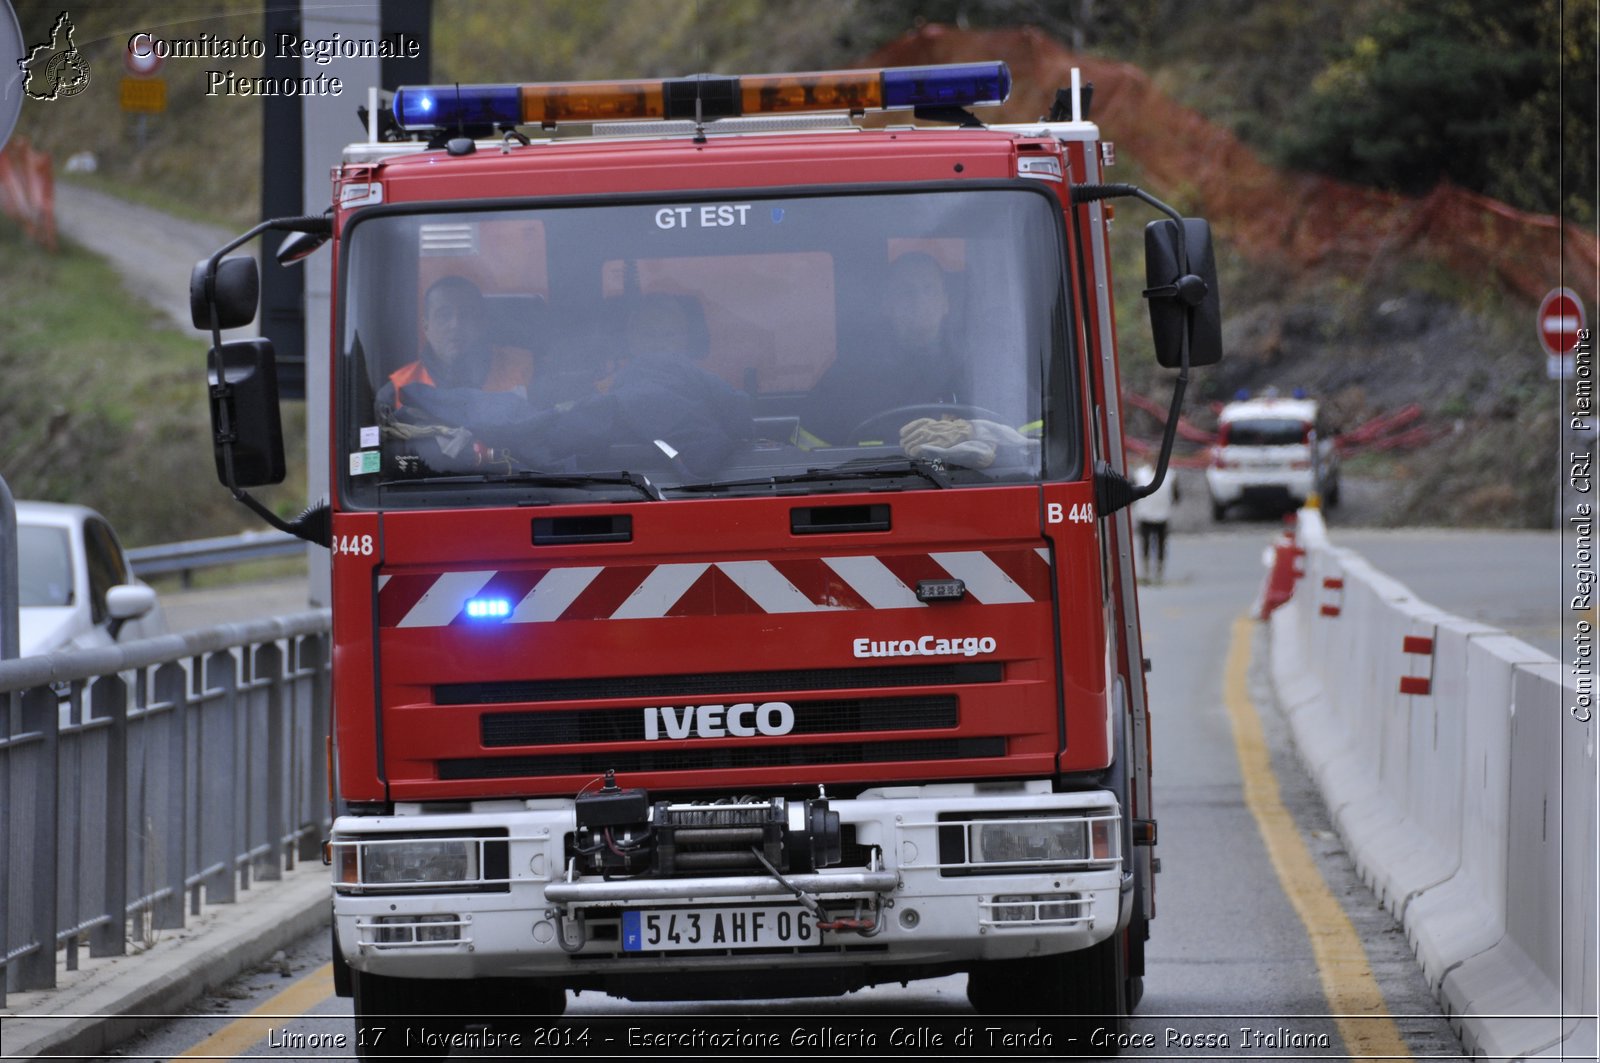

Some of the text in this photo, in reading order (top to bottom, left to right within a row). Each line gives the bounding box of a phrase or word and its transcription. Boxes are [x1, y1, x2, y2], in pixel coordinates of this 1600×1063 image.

[655, 205, 751, 229] GT EST
[1048, 503, 1093, 524] B 448
[853, 635, 997, 658] EuroCargo
[644, 702, 795, 740] IVECO
[629, 910, 811, 945] F 543 AHF 06
